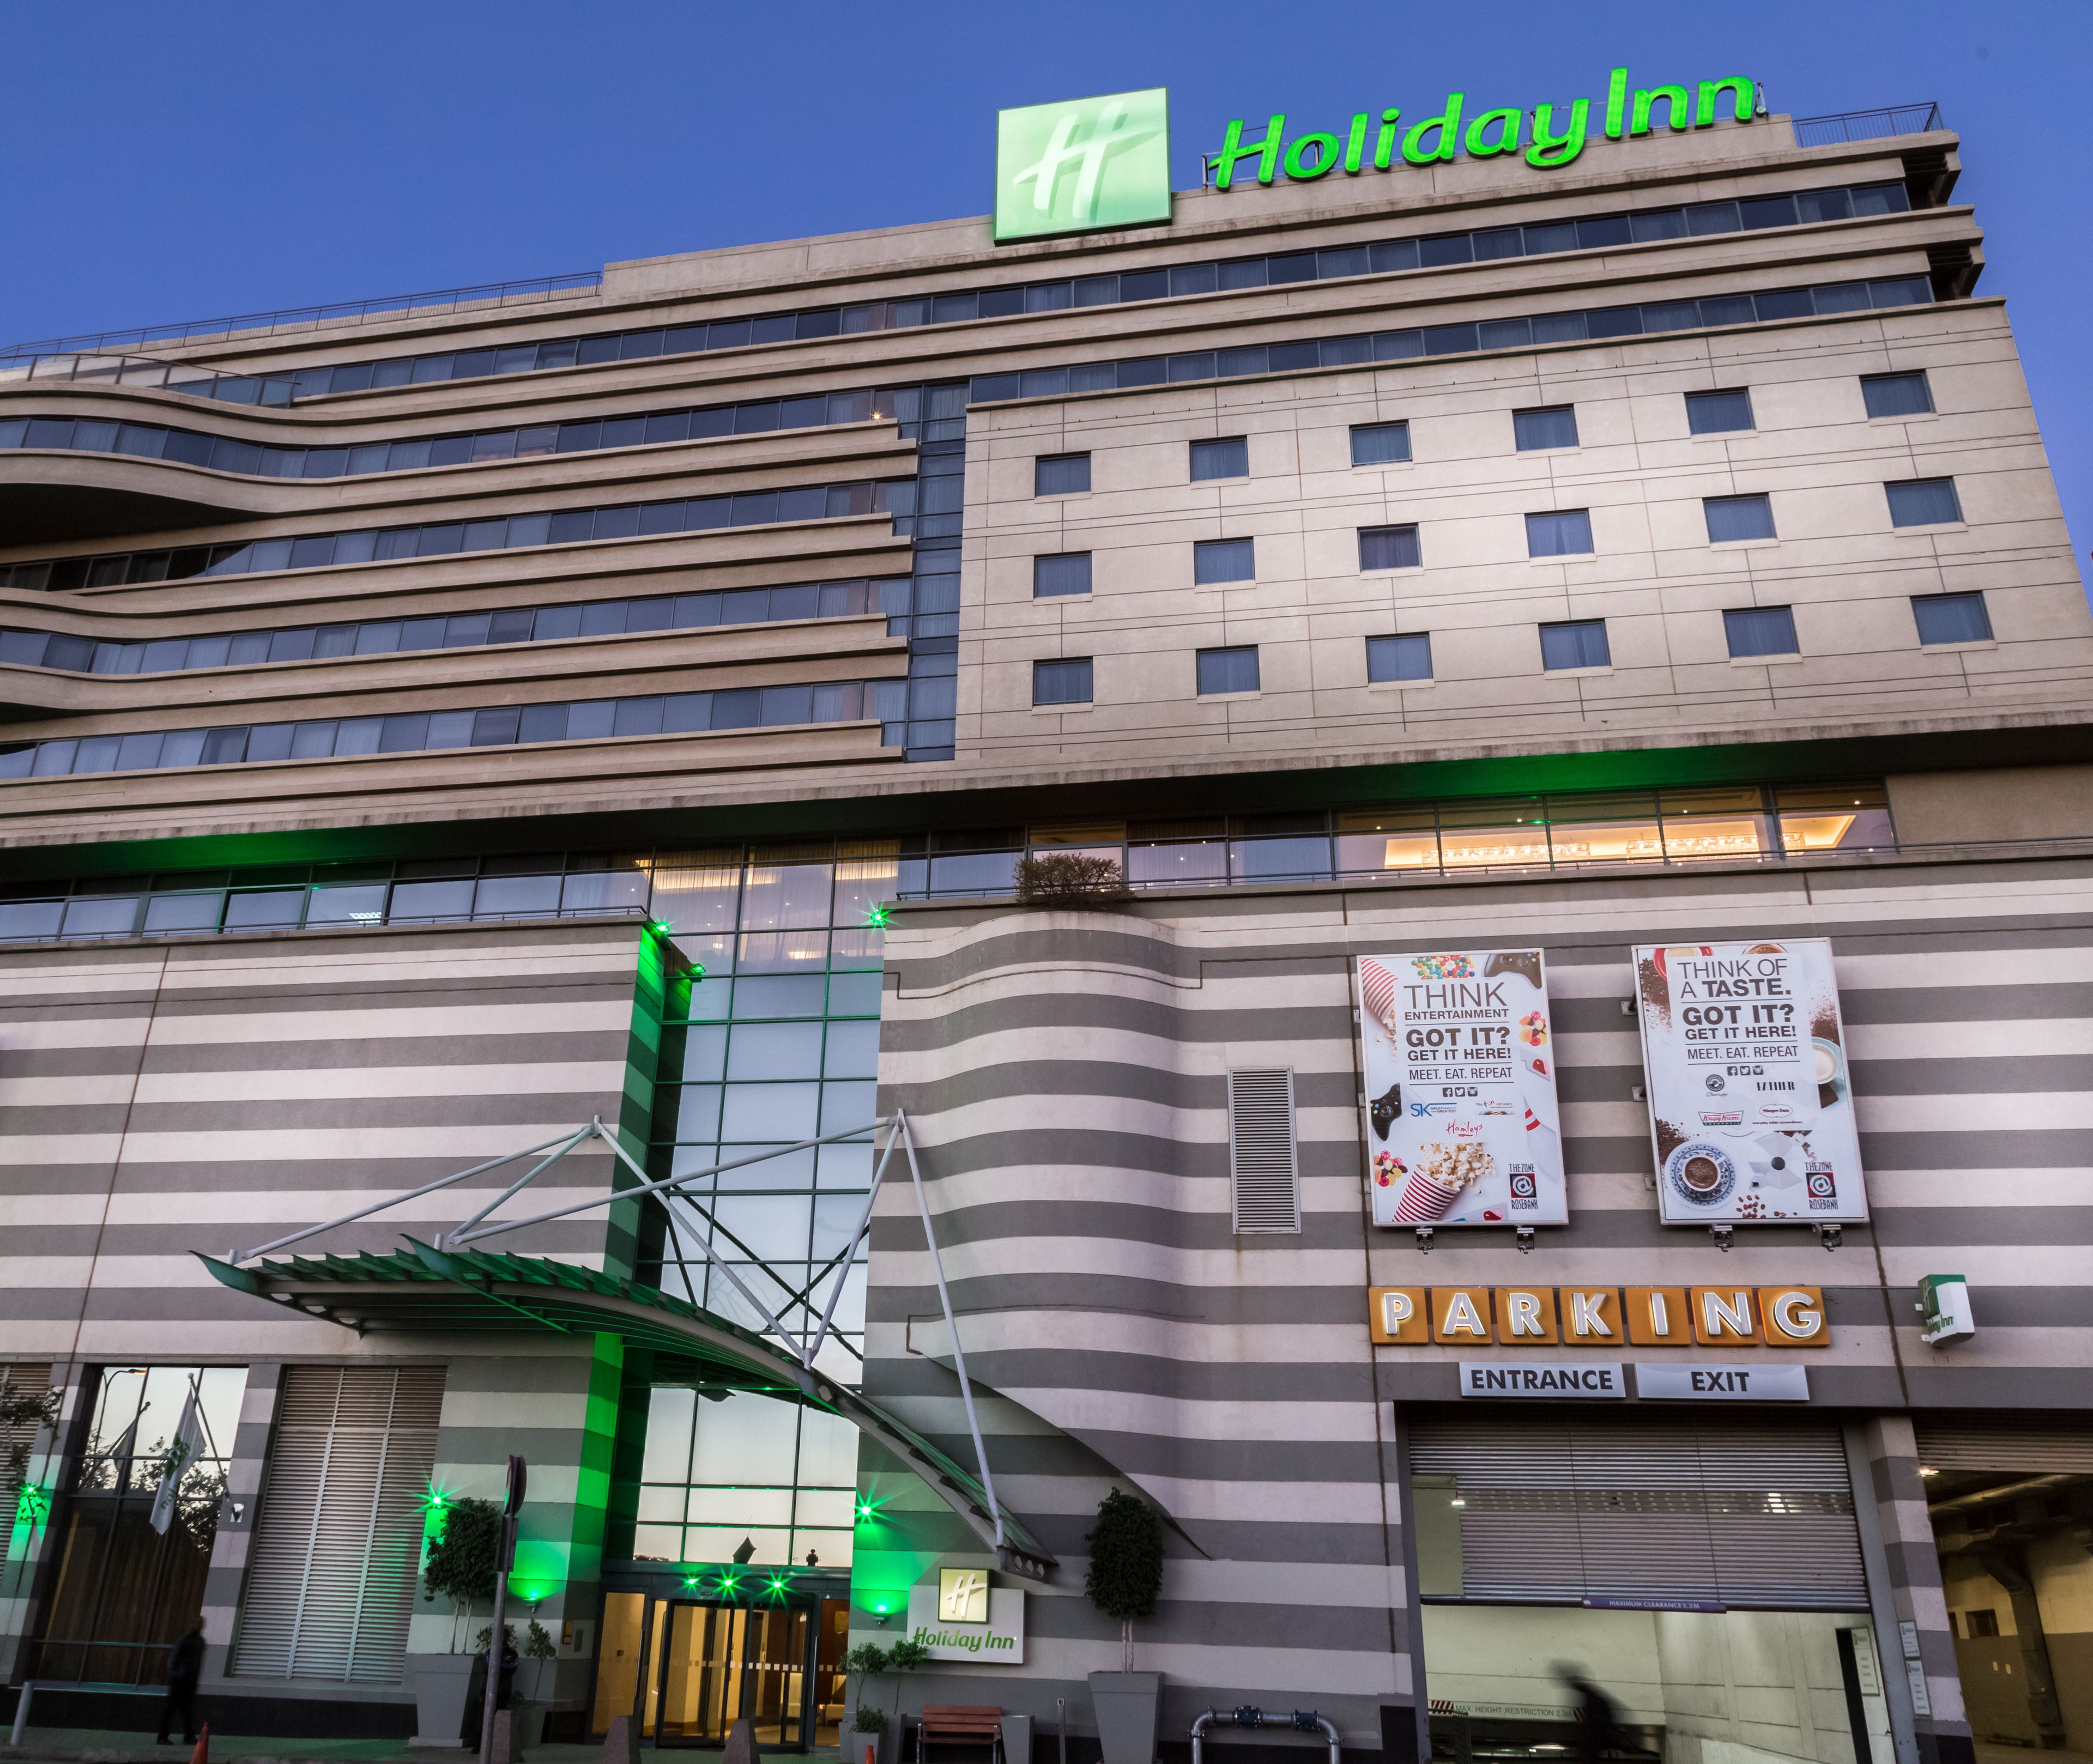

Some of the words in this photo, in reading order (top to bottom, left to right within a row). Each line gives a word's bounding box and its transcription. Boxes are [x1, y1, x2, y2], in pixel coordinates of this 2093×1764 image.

[1208, 92, 1590, 191] Holiday
[1605, 66, 1755, 141] Inn
[1677, 959, 1752, 979] THINK
[1758, 958, 1787, 976] OF
[1404, 982, 1508, 1009] THINK
[1680, 981, 1697, 998] A
[1702, 978, 1791, 997] TASTE.
[1405, 1009, 1509, 1020] ENTERTAINMENT
[1683, 1005, 1741, 1026] GOT
[1752, 1003, 1794, 1023] IT?
[1406, 1028, 1461, 1047] GOT
[1471, 1027, 1510, 1045] IT?
[1685, 1028, 1718, 1040] GET
[1725, 1027, 1739, 1039] IT
[1745, 1026, 1796, 1038] HERE!
[1408, 1050, 1439, 1061] GET
[1444, 1049, 1458, 1060] IT
[1464, 1048, 1511, 1059] HERE!
[1687, 1048, 1722, 1059] MEET.
[1726, 1047, 1750, 1058] EAT.
[1753, 1046, 1798, 1057] REPEAT
[1410, 1069, 1441, 1080] MEET.
[1445, 1069, 1467, 1079] EAT.
[1471, 1068, 1513, 1078] REPEAT
[1445, 1119, 1483, 1137] Hamleys
[1511, 1199, 1538, 1209] ROSEBANK
[1809, 1199, 1838, 1209] ROSEBANK
[1383, 1291, 1822, 1338] PARKING
[1471, 1369, 1613, 1390] ENTRANCE
[1692, 1371, 1749, 1392] EXIT
[913, 1627, 982, 1652] Holiday
[985, 1630, 1015, 1650] Inn
[1505, 1707, 1554, 1716] RESTRICTION
